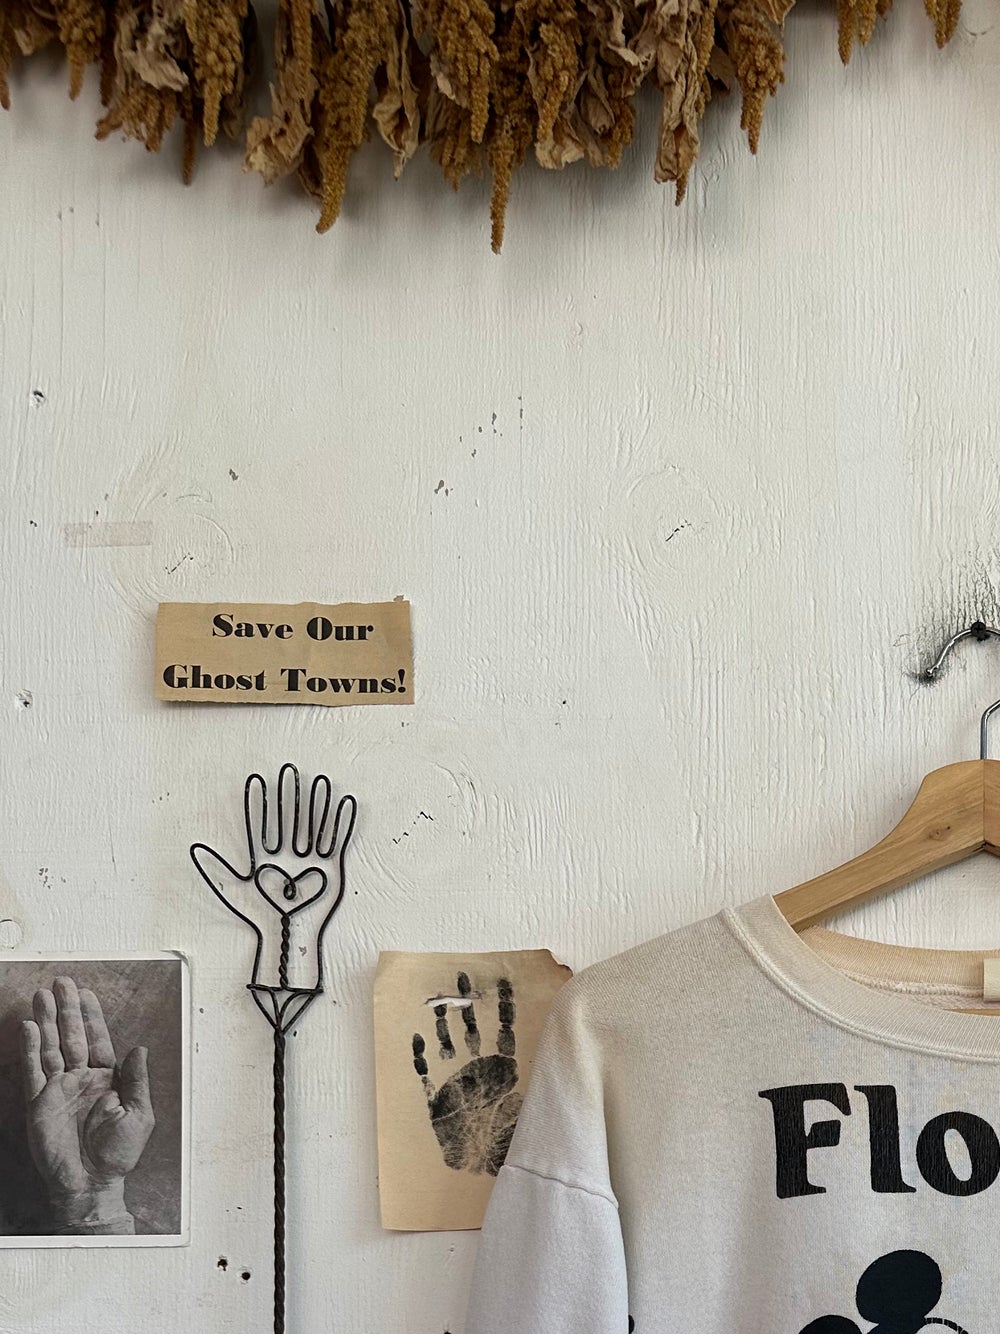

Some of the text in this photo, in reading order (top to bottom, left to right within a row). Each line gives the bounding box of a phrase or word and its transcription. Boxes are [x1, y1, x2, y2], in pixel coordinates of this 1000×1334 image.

[212, 613, 374, 642] Save Our
[162, 663, 407, 694] Ghost Towns!
